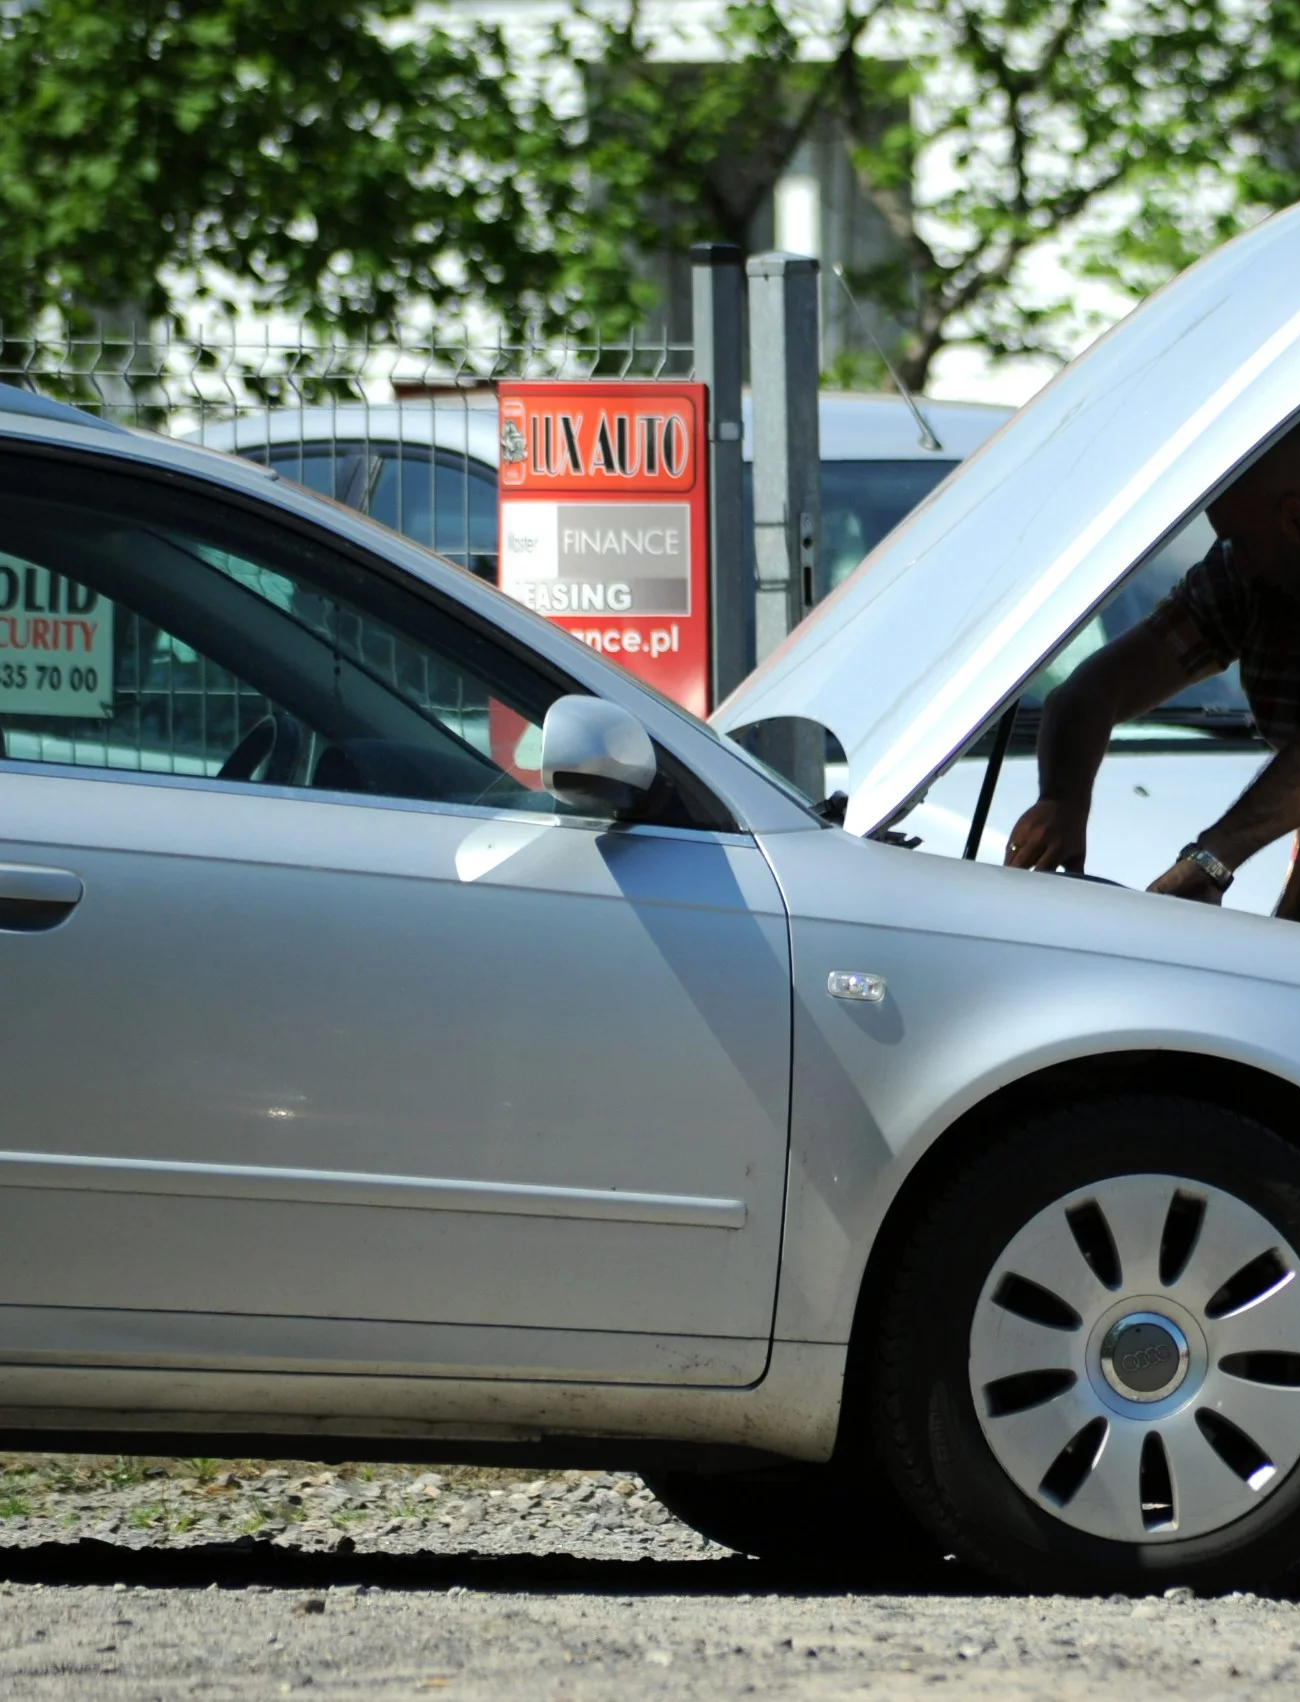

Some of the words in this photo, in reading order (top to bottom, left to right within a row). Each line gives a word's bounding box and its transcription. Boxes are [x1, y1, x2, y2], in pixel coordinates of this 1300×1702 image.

[529, 411, 585, 477] LUX
[589, 409, 689, 478] AUTO
[564, 529, 679, 556] FINANCE
[517, 582, 632, 612] EASING
[0, 663, 28, 690] 35
[35, 664, 62, 692] 70
[70, 667, 98, 693] 00
